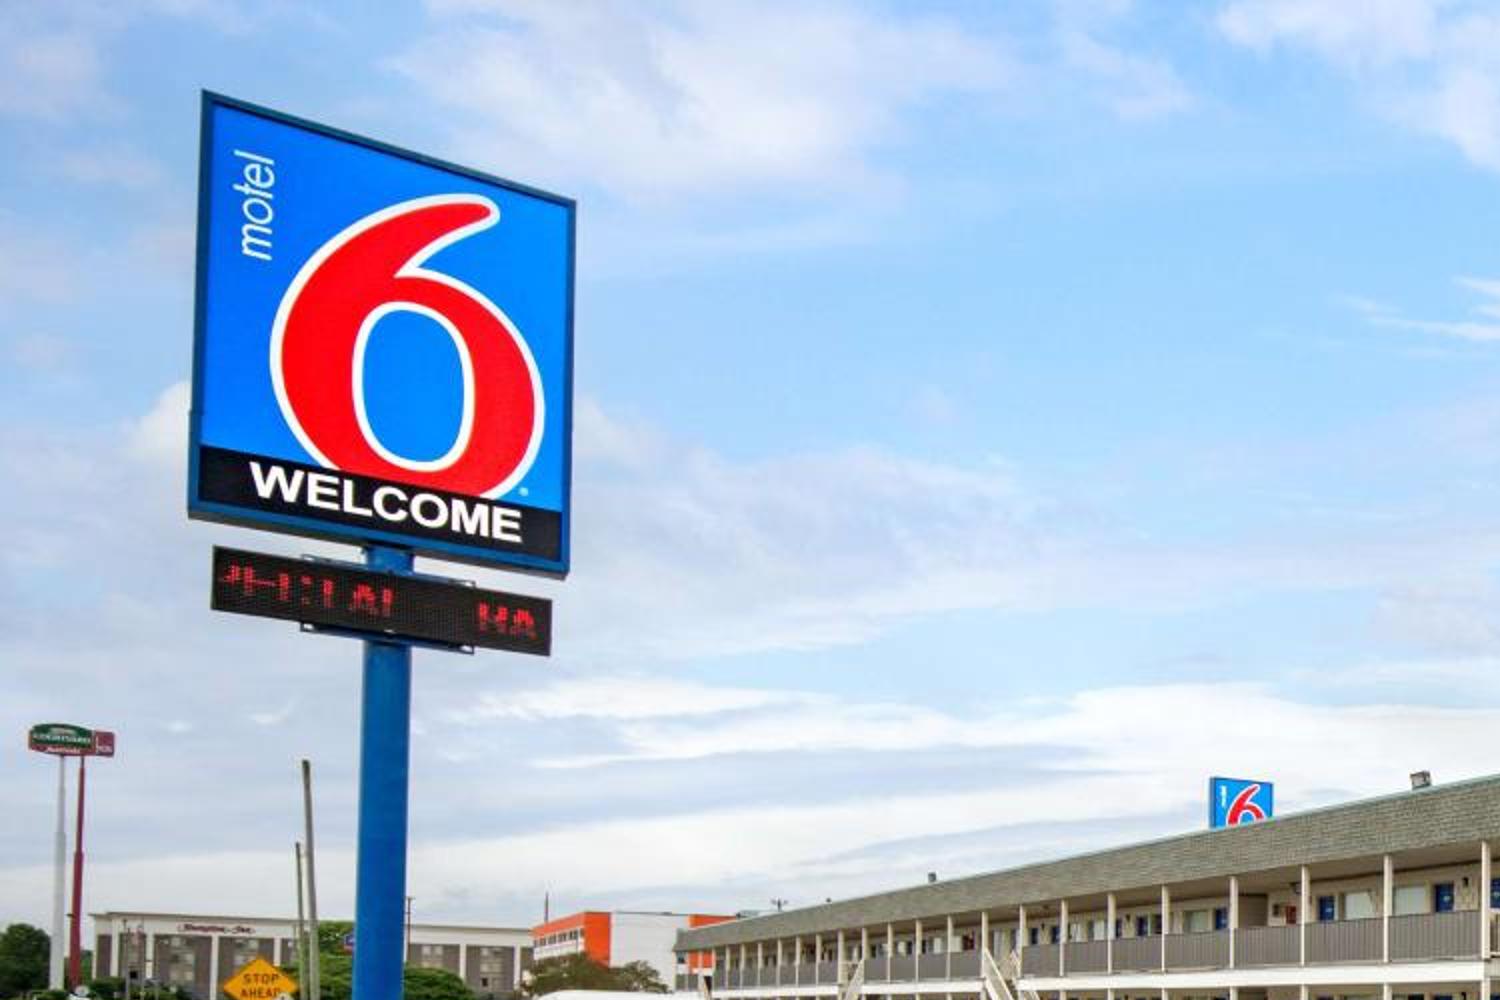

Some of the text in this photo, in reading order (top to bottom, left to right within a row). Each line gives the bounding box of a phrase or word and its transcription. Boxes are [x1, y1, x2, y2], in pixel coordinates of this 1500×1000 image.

[233, 149, 275, 260] motel
[270, 193, 545, 498] 6
[250, 461, 522, 543] WELCOME
[1226, 784, 1265, 826] 6
[243, 972, 279, 985] STOP
